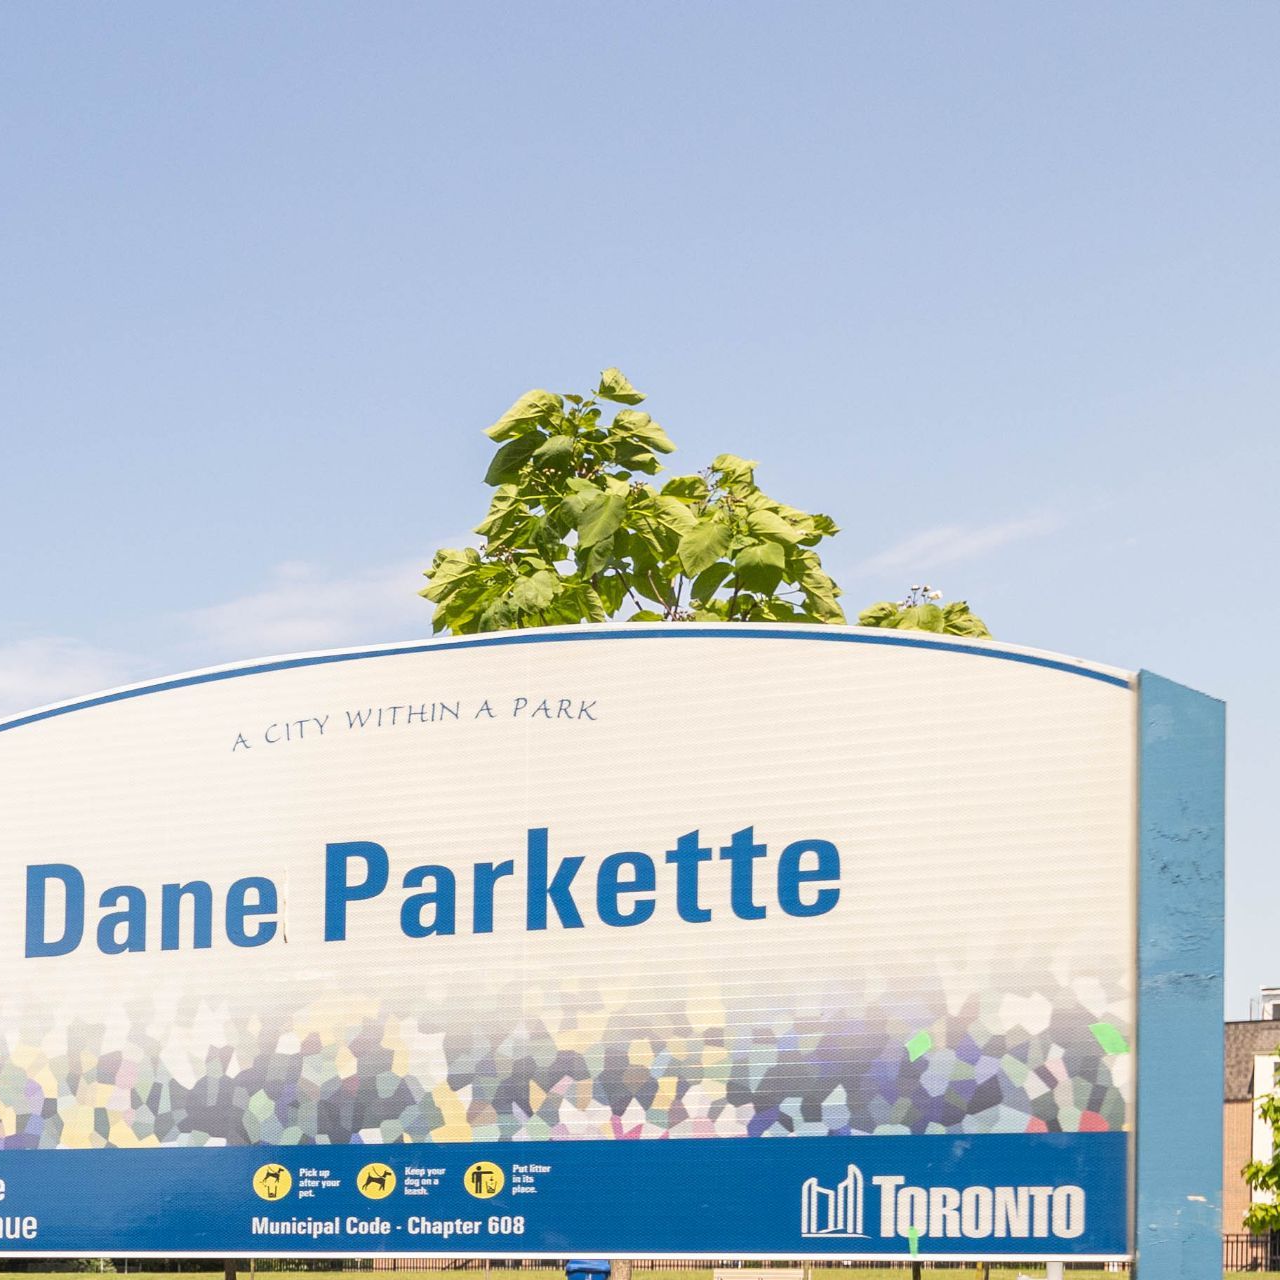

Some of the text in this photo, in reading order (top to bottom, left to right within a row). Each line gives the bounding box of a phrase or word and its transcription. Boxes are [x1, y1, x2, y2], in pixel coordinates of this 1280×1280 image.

[232, 696, 599, 752] A CITY WITHIN A PARK
[24, 825, 842, 960] Dane Parkette
[299, 1167, 330, 1179] Pick up
[404, 1166, 446, 1177] Keep your
[512, 1163, 551, 1173] Put litter
[299, 1178, 342, 1189] after your
[404, 1177, 439, 1187] dog on a
[512, 1174, 535, 1183] in its
[299, 1189, 316, 1199] pet.
[872, 1175, 1086, 1239] TORONTO
[251, 1216, 340, 1239] Municipal
[345, 1216, 391, 1235] Code
[407, 1216, 482, 1239] Chapter
[487, 1215, 525, 1235] 608
